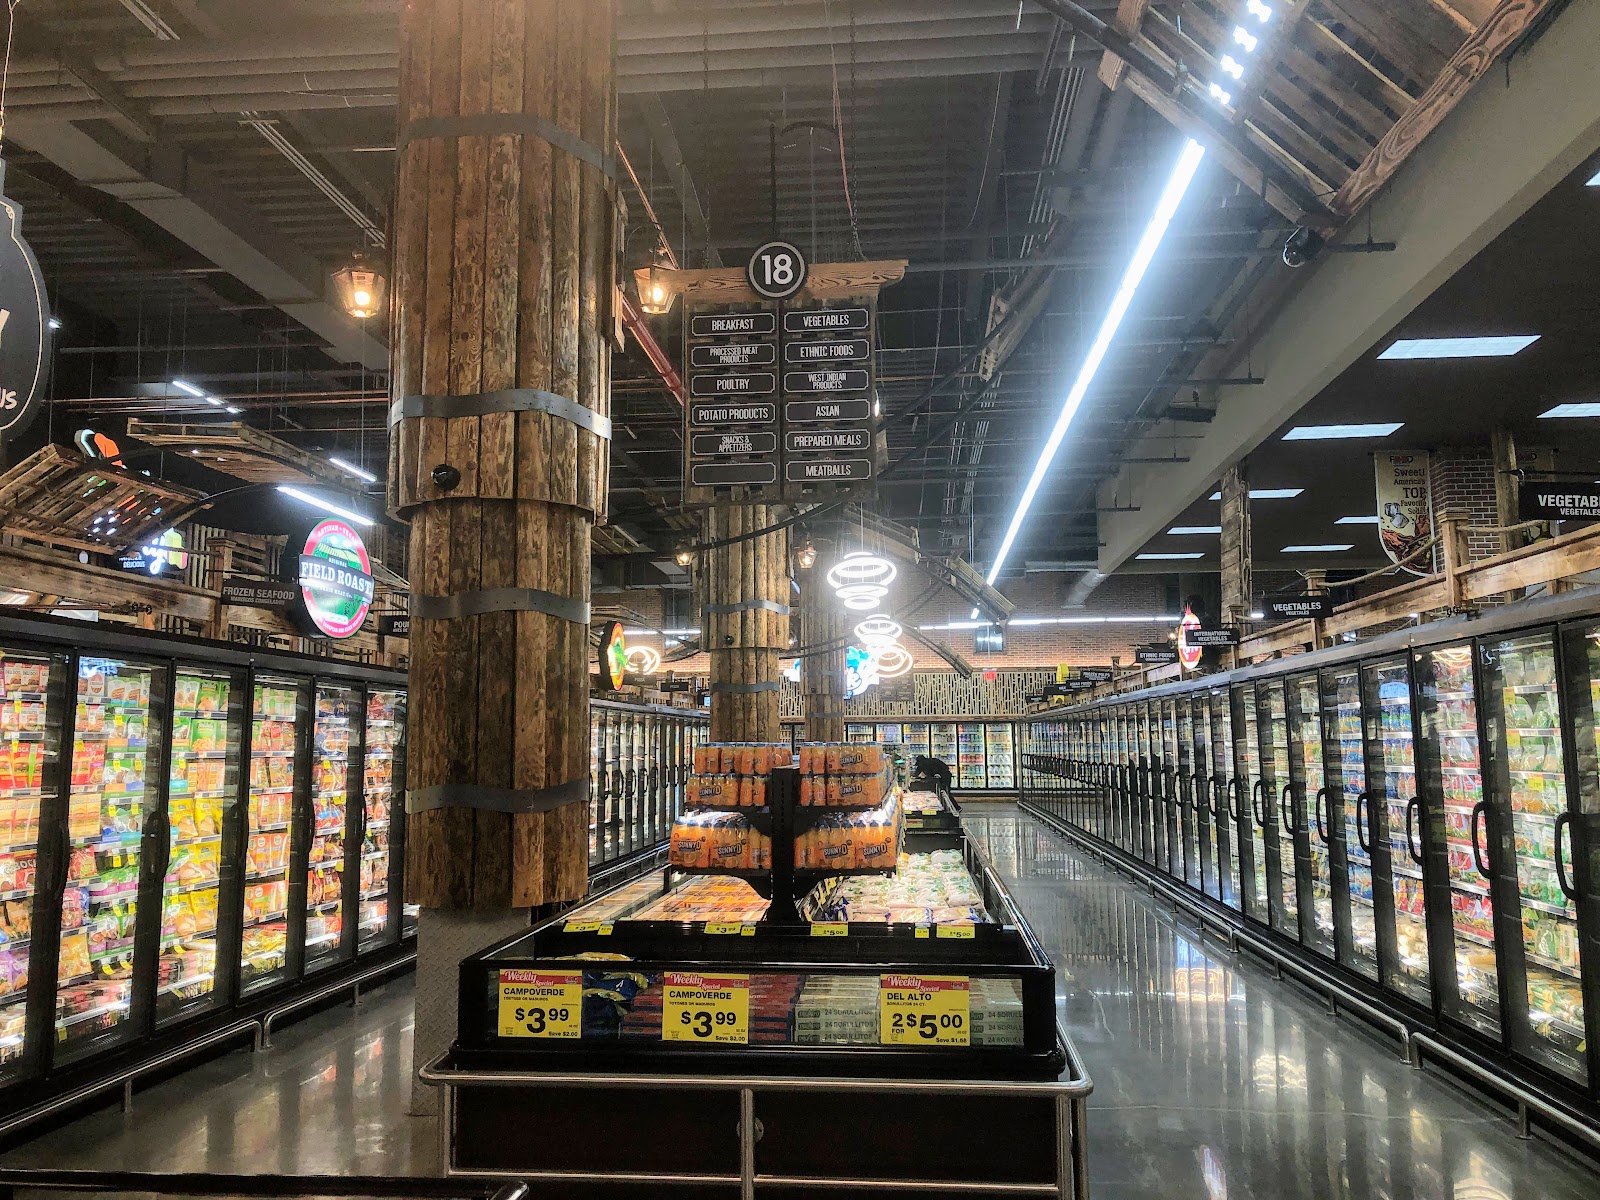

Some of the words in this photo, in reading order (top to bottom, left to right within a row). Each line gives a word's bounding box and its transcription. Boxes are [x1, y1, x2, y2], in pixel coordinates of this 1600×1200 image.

[762, 254, 793, 285] 18
[712, 319, 754, 330] BREAKFAST
[803, 315, 849, 327] VEGETABLES
[710, 347, 741, 356] PROCESSED
[742, 346, 758, 354] MEAT
[800, 346, 827, 358] ETHNIC
[830, 345, 854, 356] FOODS
[720, 354, 748, 364] PRODUCTS
[808, 374, 824, 382] WEST
[826, 373, 846, 382] INDIAN
[716, 379, 750, 390] POULTRY
[812, 380, 842, 389] PRODUCTS
[699, 410, 727, 420] POTATO
[729, 408, 768, 419] PRODUCTS
[816, 405, 839, 416] ASIAN
[722, 436, 743, 445] SNACKS
[744, 436, 749, 444] &
[794, 436, 832, 447] PREPARED
[834, 435, 861, 446] MEALS
[719, 443, 752, 452] APPETIZERS
[806, 465, 851, 477] MEATBALLS
[1403, 488, 1427, 498] TOP
[301, 562, 335, 581] FIELD
[337, 570, 372, 594] ROAST
[223, 586, 254, 596] FROZEN
[257, 589, 294, 599] SEAFOOD
[1273, 602, 1321, 611] VEGETABLES
[678, 841, 701, 850] SUNNYD
[718, 843, 742, 854] SUNNYD
[505, 971, 537, 983] Weekly
[671, 973, 703, 986] Weekly
[888, 976, 921, 989] Weekly
[504, 988, 564, 996] CAMPOVERDE
[670, 991, 731, 999] CAMPOVERDE
[892, 1013, 903, 1027] 2
